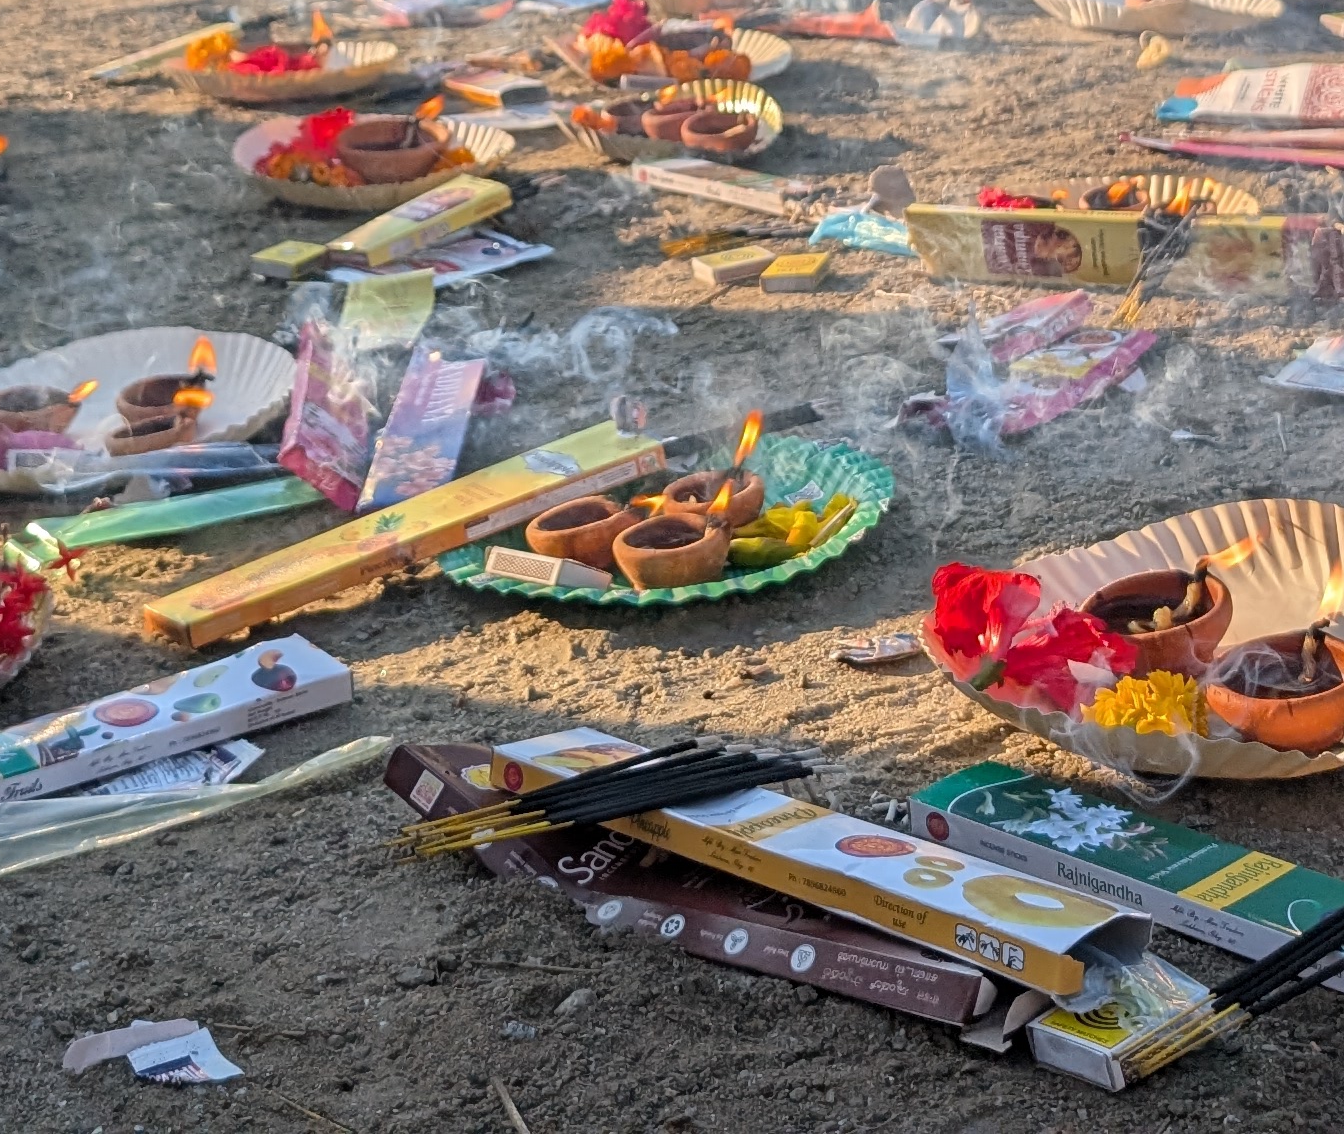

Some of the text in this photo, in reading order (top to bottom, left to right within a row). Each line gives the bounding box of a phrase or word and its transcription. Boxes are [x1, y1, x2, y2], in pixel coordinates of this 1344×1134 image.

[1057, 860, 1143, 907] Rajnigandha
[1195, 857, 1283, 903] Rajnigandha
[873, 894, 929, 925] Direction of
